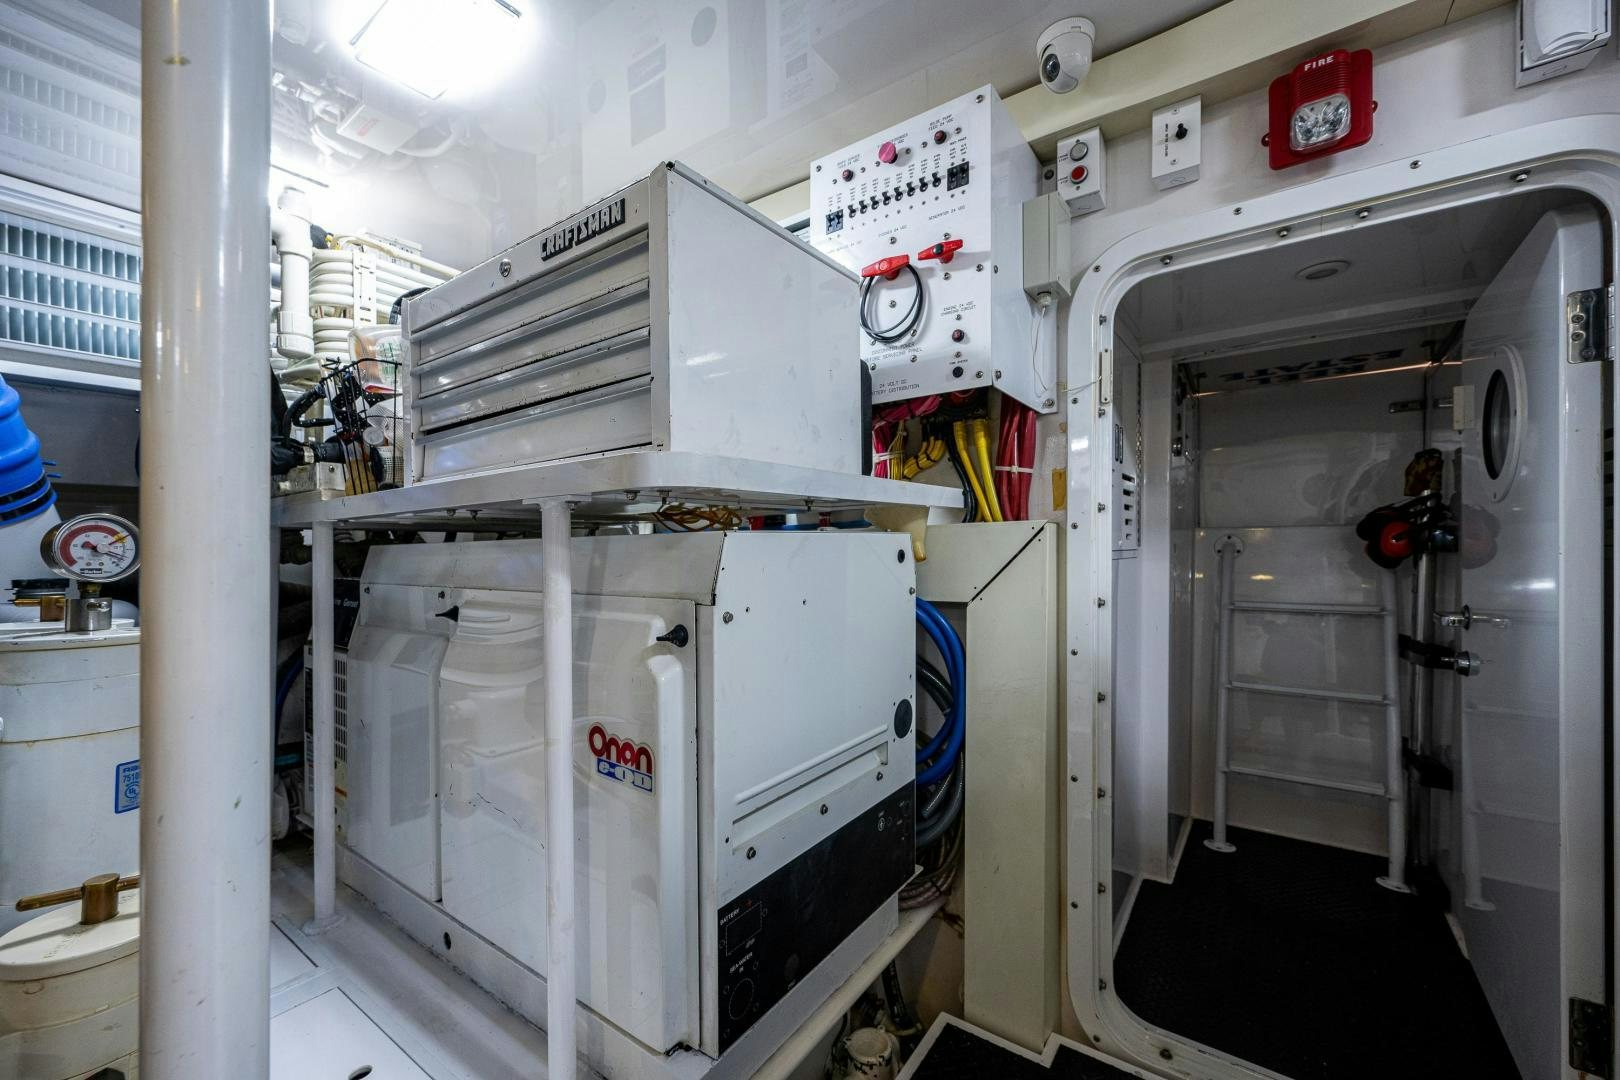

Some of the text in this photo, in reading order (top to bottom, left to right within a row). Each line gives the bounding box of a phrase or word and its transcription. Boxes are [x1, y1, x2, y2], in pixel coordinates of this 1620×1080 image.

[1304, 55, 1334, 71] FIRE
[540, 199, 625, 261] CRAFTSMAN
[888, 383, 920, 394] DISTRIBUTION
[343, 598, 359, 608] Genset
[588, 725, 653, 774] Onan
[719, 907, 741, 926] BATTERY
[729, 951, 753, 974] SEA-WATER
